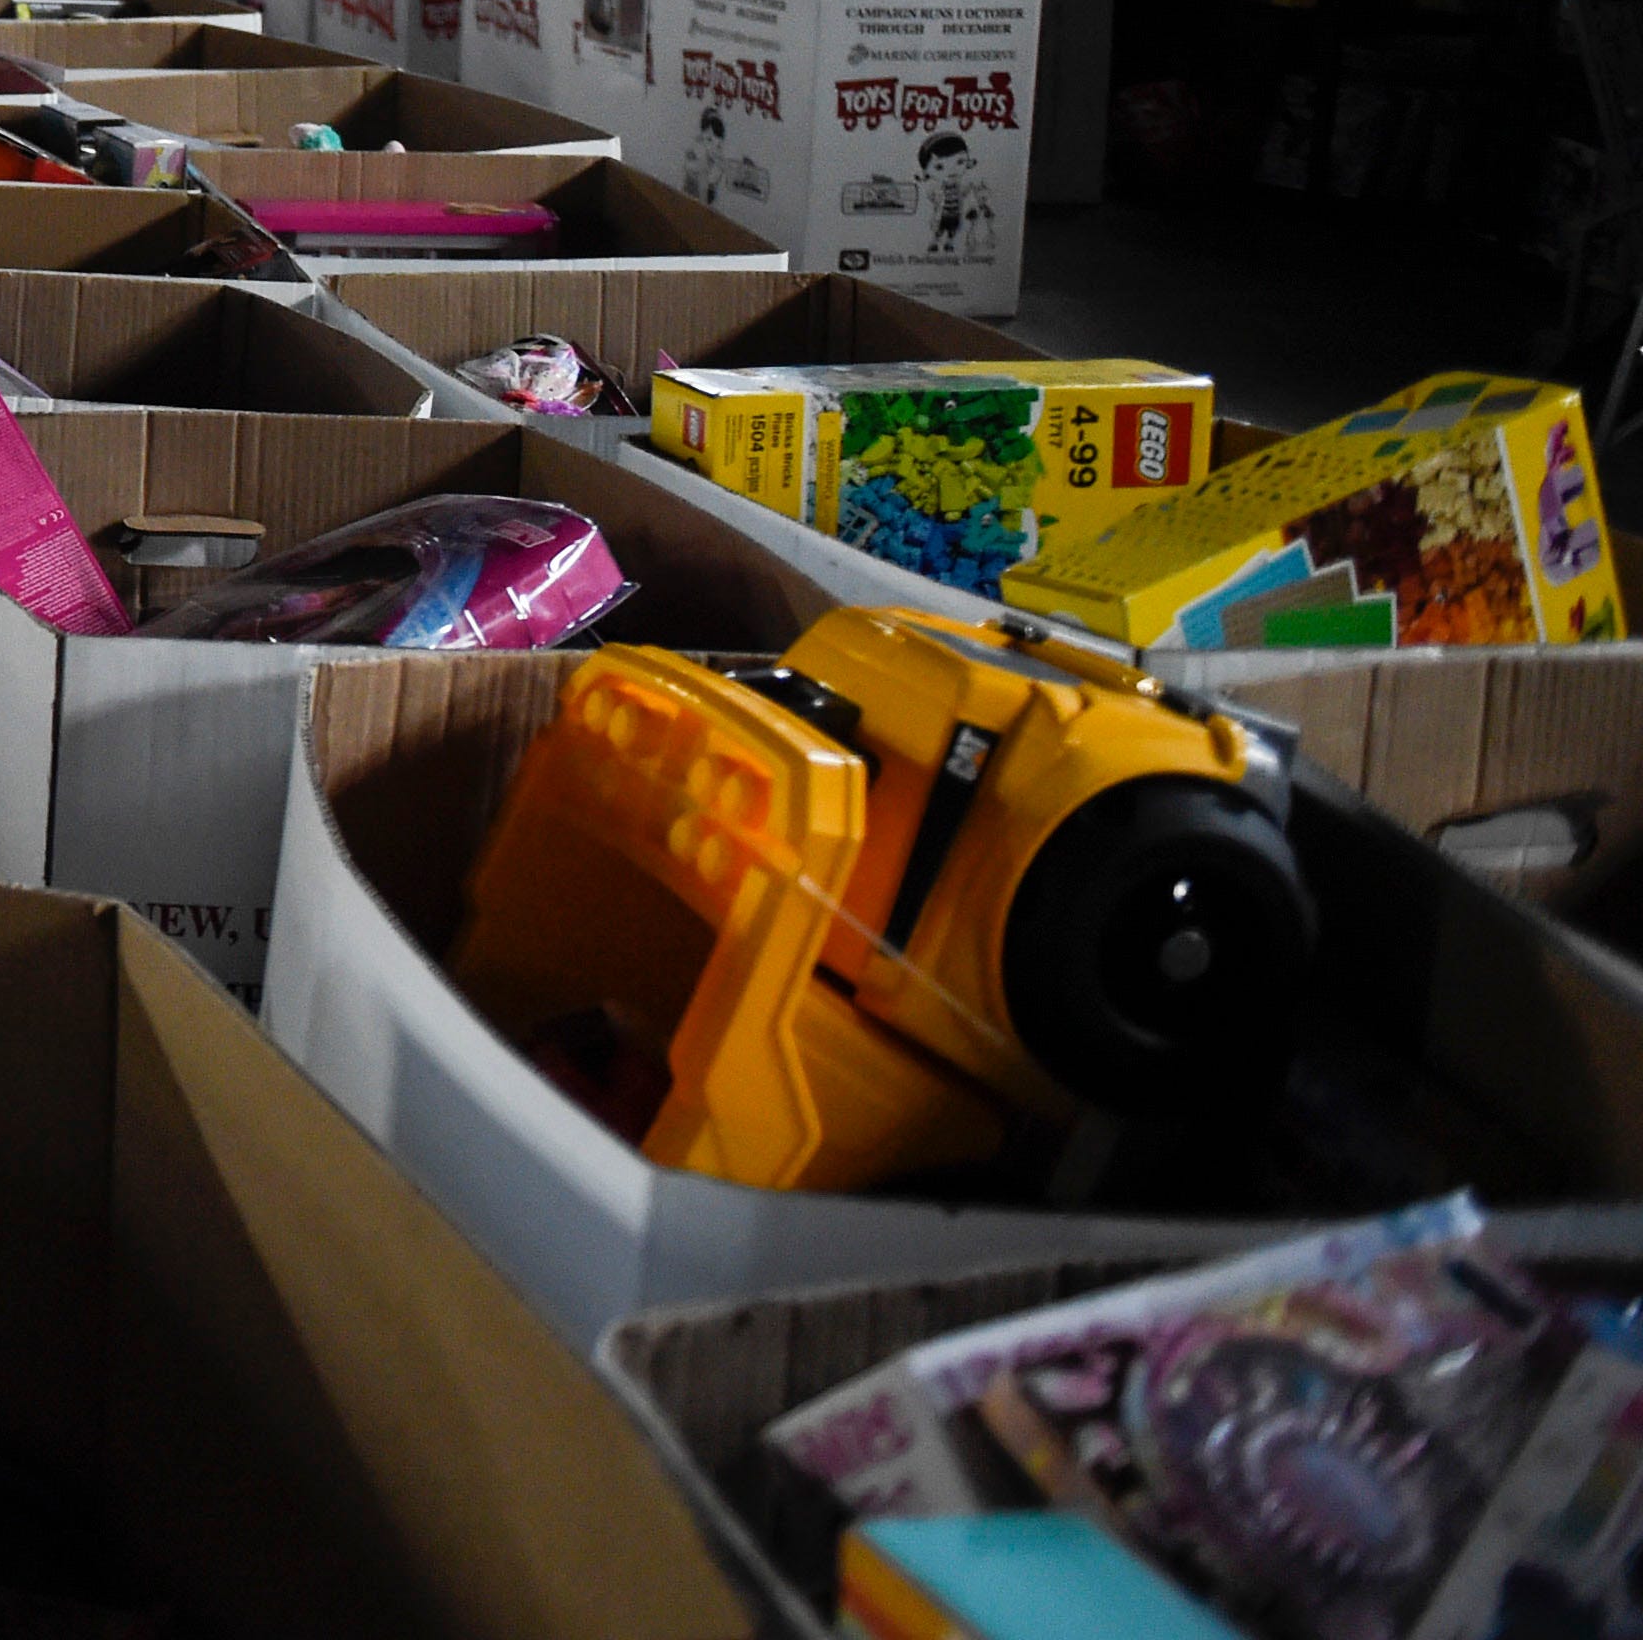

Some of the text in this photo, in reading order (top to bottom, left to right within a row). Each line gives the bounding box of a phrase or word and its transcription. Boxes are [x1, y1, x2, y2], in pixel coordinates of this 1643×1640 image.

[845, 8, 917, 19] CAMPAIGN
[920, 8, 953, 19] RUNS
[965, 8, 1025, 19] OCTOBER
[859, 23, 1012, 35] THROUGH DECEMBER
[868, 50, 1016, 61] MARINE CORPS RESERVE
[840, 85, 1008, 118] TOYS FOR TOTS
[750, 413, 766, 453] 1504
[1048, 406, 1064, 449] 11717
[1069, 404, 1099, 489] 4-99
[1138, 409, 1170, 482] LEGO
[782, 411, 795, 490] Bricks Bricks
